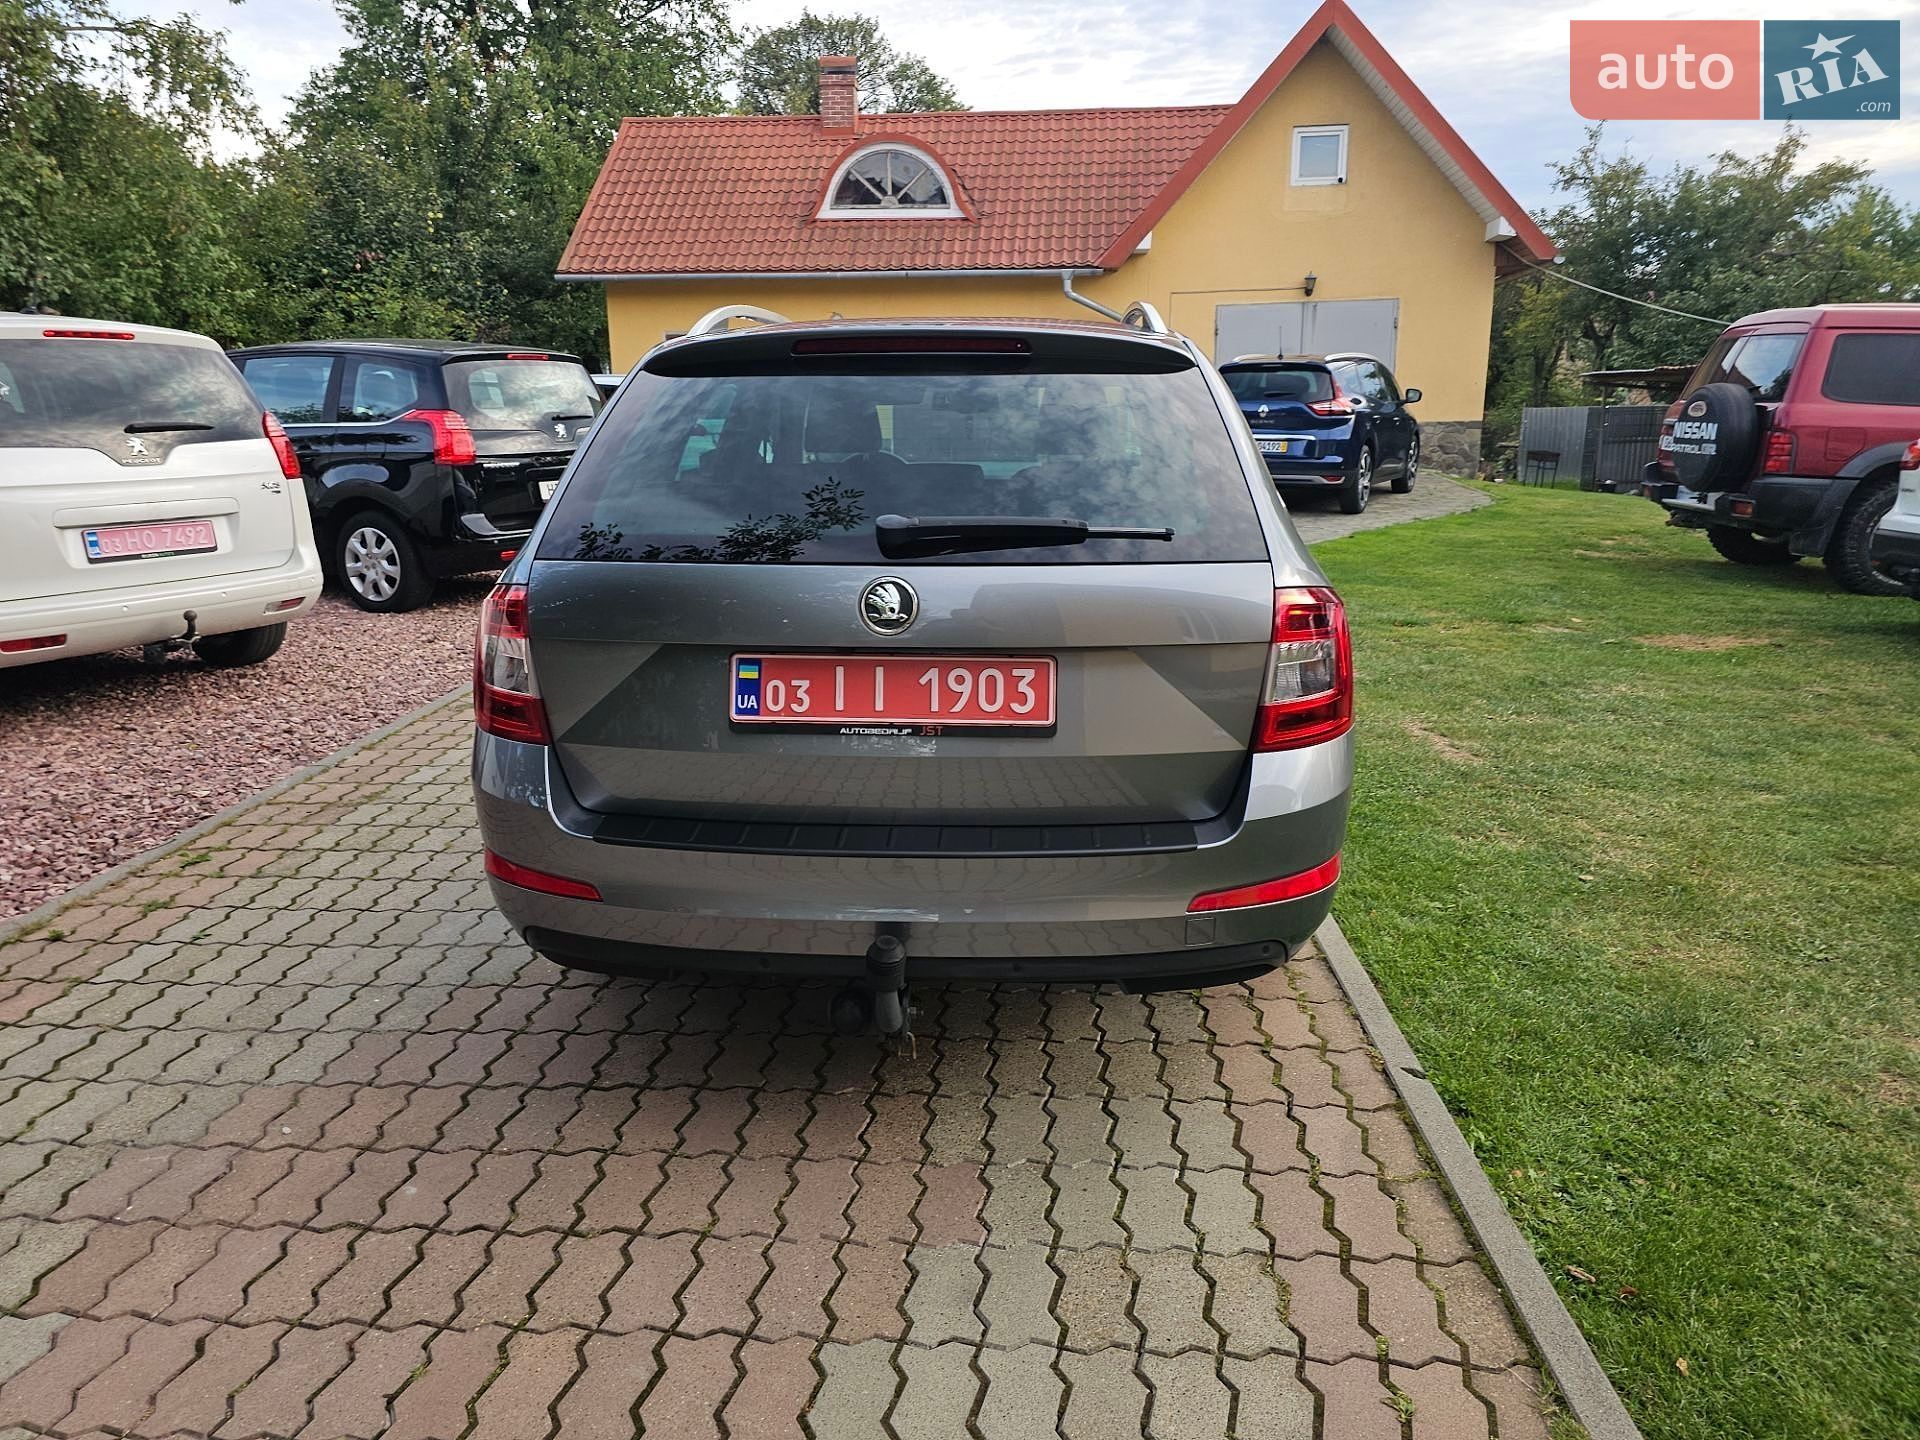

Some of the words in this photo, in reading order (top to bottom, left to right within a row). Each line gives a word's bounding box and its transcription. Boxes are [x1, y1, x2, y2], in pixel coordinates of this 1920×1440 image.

[1673, 421, 1718, 440] NISSAN
[102, 537, 122, 553] 03
[161, 525, 209, 548] 7492
[765, 679, 810, 713] 03
[918, 667, 1036, 714] 1903
[737, 694, 758, 709] UA
[920, 725, 943, 736] JST
